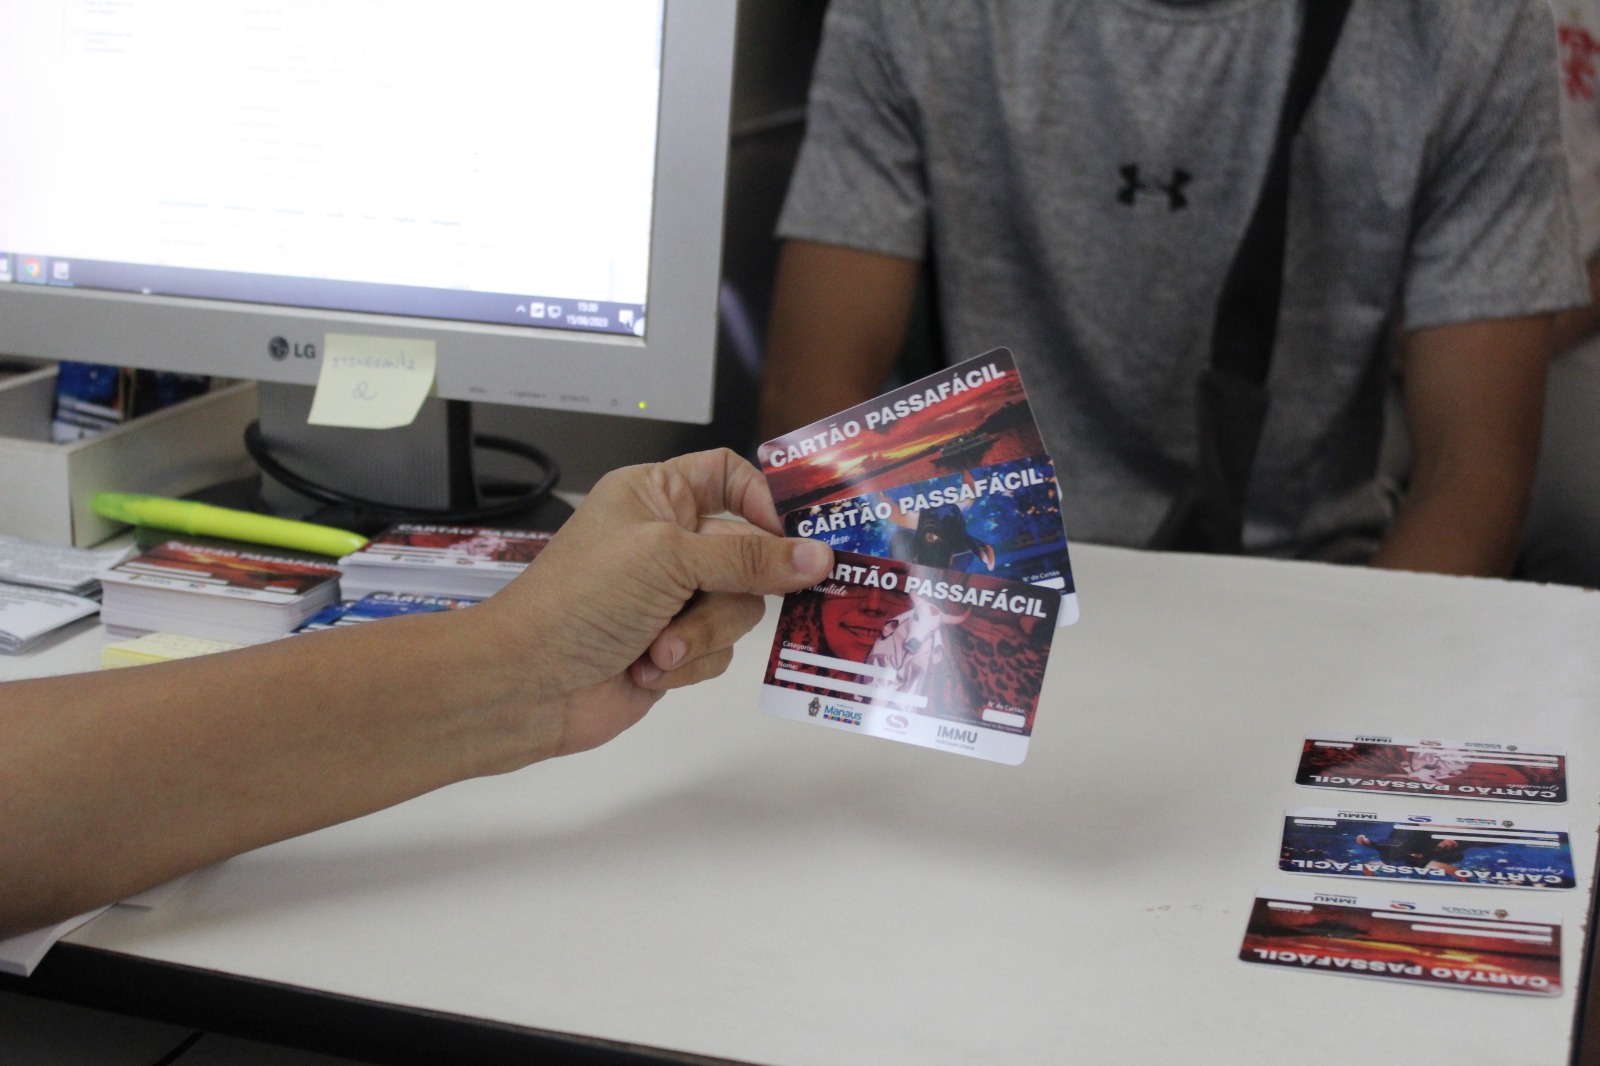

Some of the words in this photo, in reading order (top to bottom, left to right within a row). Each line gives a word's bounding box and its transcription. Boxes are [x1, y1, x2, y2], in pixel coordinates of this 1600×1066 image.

[293, 344, 316, 359] LG
[770, 421, 861, 467] CARTÃO
[865, 363, 1006, 429] PASSAFÁCIL
[797, 501, 892, 538] CARTÃO
[899, 468, 1044, 515] PASSAFÁCIL
[828, 563, 898, 590] RTÃO
[904, 576, 1048, 618] PASSAFÁCIL
[778, 660, 799, 670] Nome:
[824, 704, 863, 720] Manaus
[936, 724, 978, 744] IMMU
[1309, 775, 1450, 791] PASSAFÁCIL
[1458, 785, 1557, 798] CARTÃO
[1291, 859, 1446, 877] PASSAFÁCIL
[1454, 869, 1563, 884] CARTÃO
[1314, 896, 1357, 905] IMMU
[1253, 949, 1423, 977] PASSAFÁCIL
[1431, 967, 1549, 988] CARTÃO
